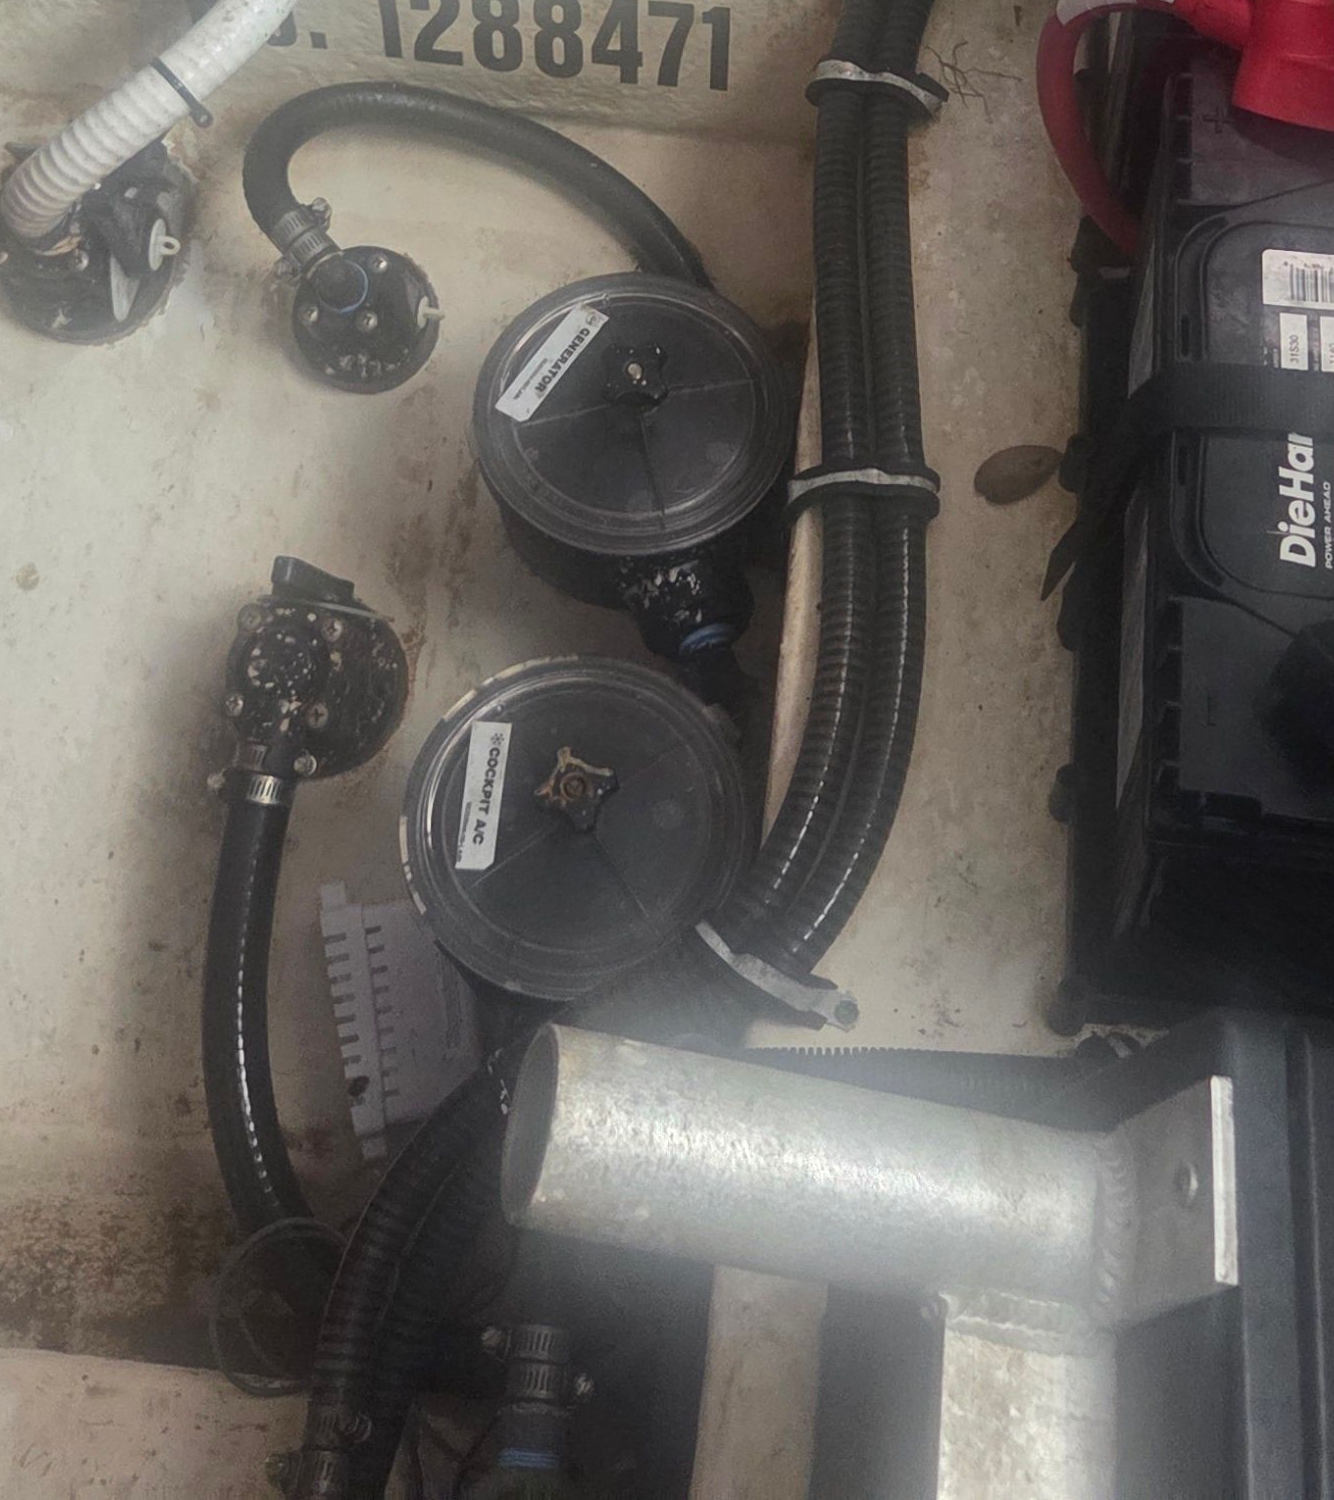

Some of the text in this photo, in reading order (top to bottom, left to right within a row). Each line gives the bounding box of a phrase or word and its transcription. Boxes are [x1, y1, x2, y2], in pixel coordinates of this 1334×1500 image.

[533, 325, 591, 394] GENERATOR
[1288, 333, 1300, 364] 31S30
[1322, 479, 1332, 569] POWER AHEAD
[472, 746, 501, 845] COCKPIT A/C
